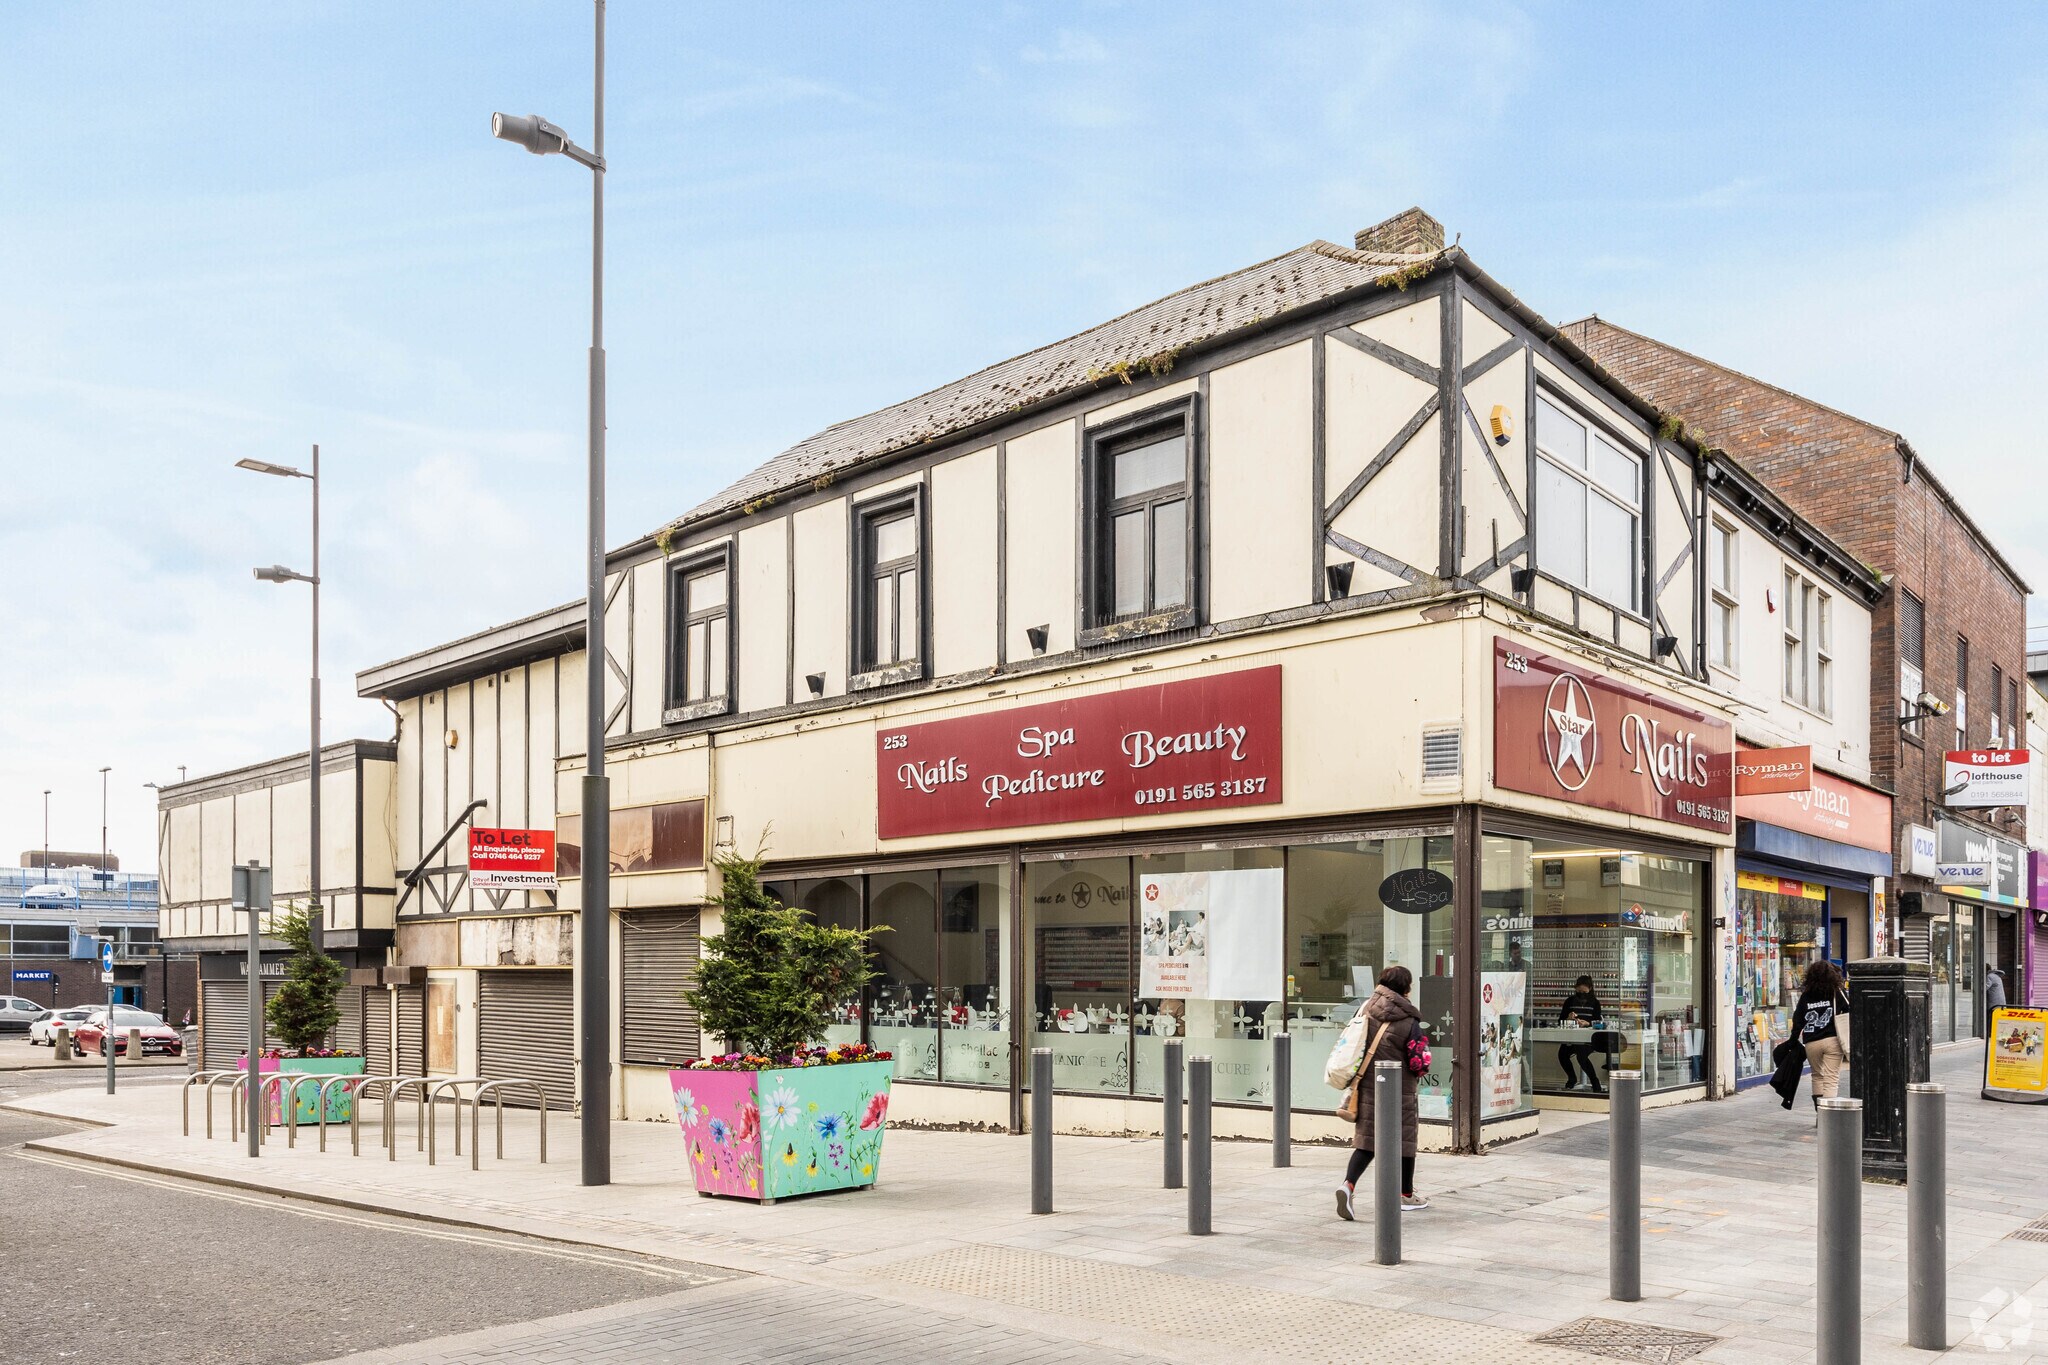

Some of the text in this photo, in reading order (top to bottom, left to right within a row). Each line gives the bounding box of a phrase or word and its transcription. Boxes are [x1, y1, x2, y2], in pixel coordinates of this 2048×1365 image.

[1505, 651, 1528, 674] 253
[1559, 716, 1585, 736] Star
[883, 734, 908, 751] 253
[1016, 725, 1076, 759] Spa
[1121, 722, 1247, 769] Beauty
[1620, 713, 1708, 796] Nails
[1971, 752, 2011, 763] to let
[897, 756, 969, 794] Nails
[1735, 762, 1804, 776] Ryman
[1971, 772, 2023, 780] lofthouse
[982, 768, 1105, 808] Pedicure
[1134, 777, 1267, 805] 0191 565 3187
[1677, 799, 1730, 824] 0191 565 3187
[472, 831, 531, 846] To Let
[484, 846, 520, 854] Enquiries,
[490, 873, 555, 884] Investment
[1385, 870, 1437, 903] Nails
[2007, 1011, 2037, 1019] DHL
[961, 1043, 998, 1057] Shellac
